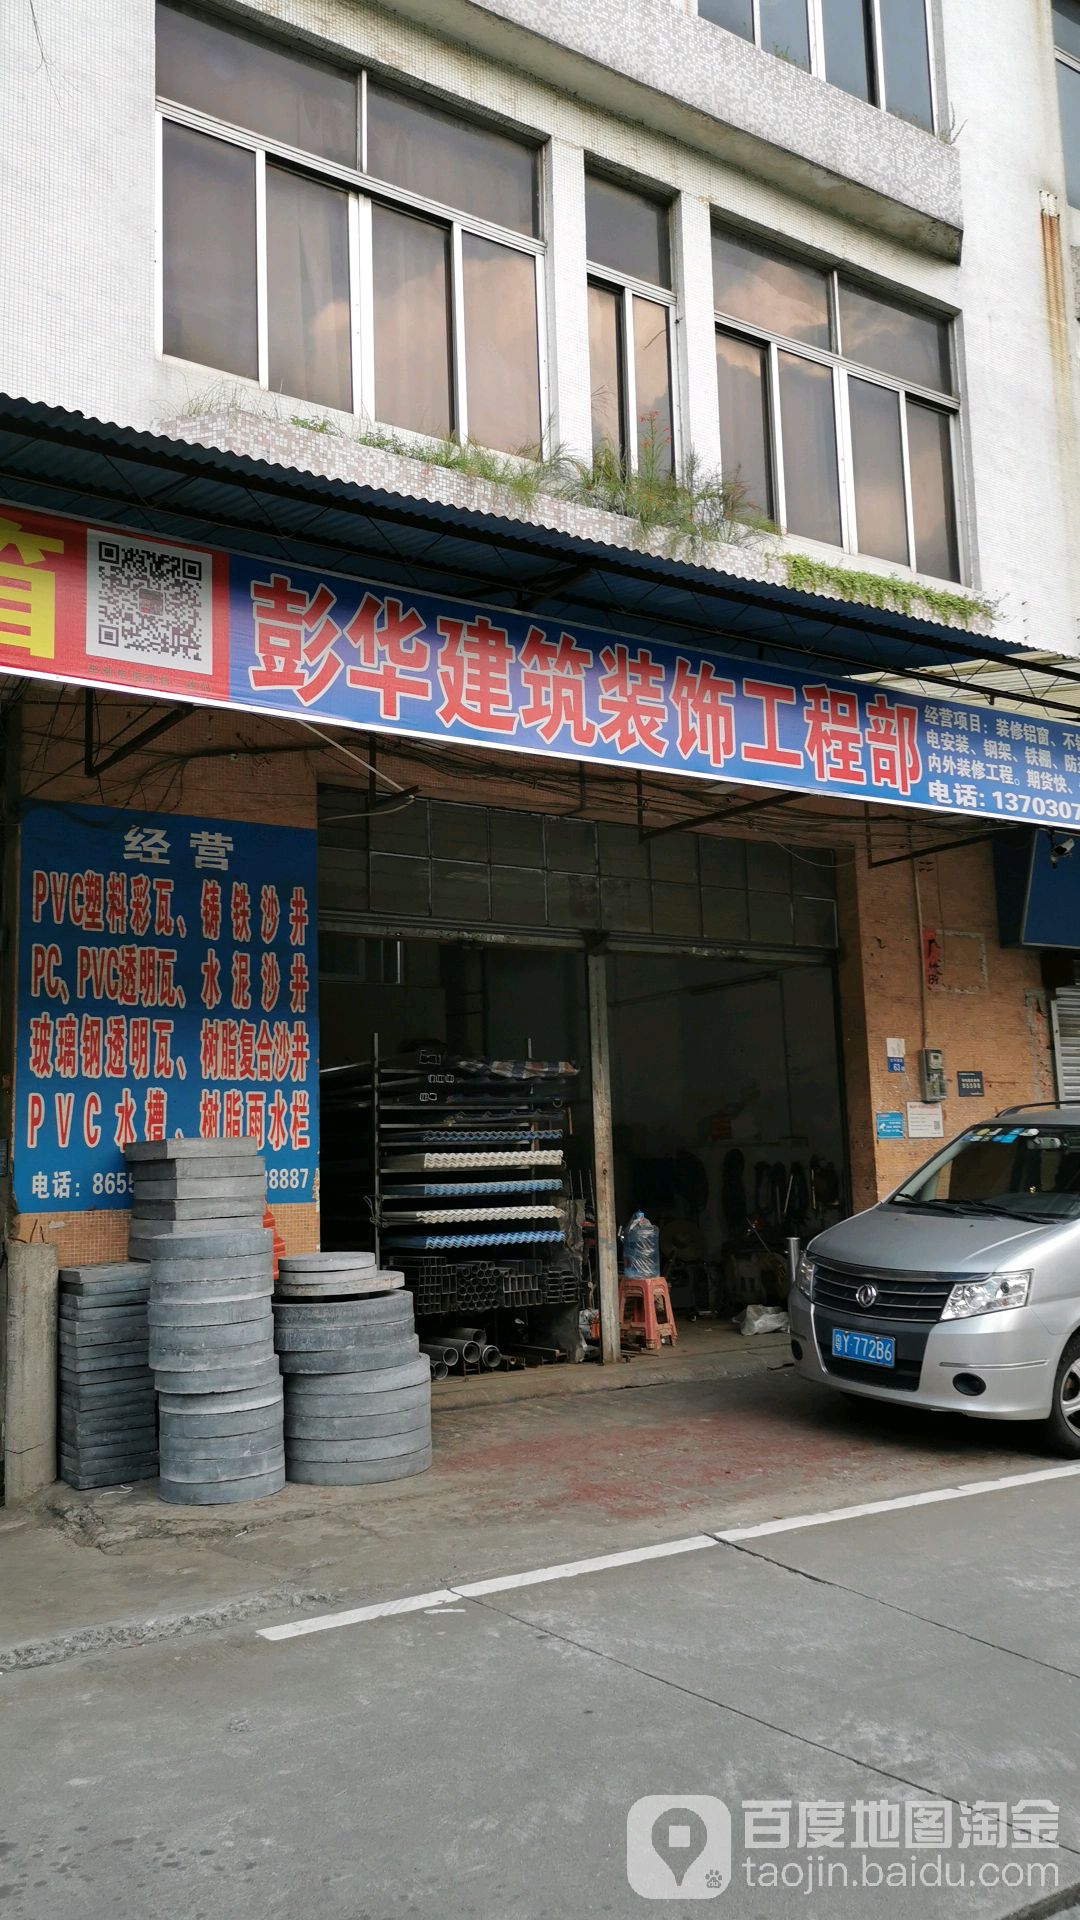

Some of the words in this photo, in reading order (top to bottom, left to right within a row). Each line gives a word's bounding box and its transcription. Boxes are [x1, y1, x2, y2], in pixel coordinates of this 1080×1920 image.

[250, 573, 922, 795] 彭华建筑装饰工程部
[928, 753, 1080, 794] 内外装修工程。期货快、
[265, 1168, 309, 1190] 8887
